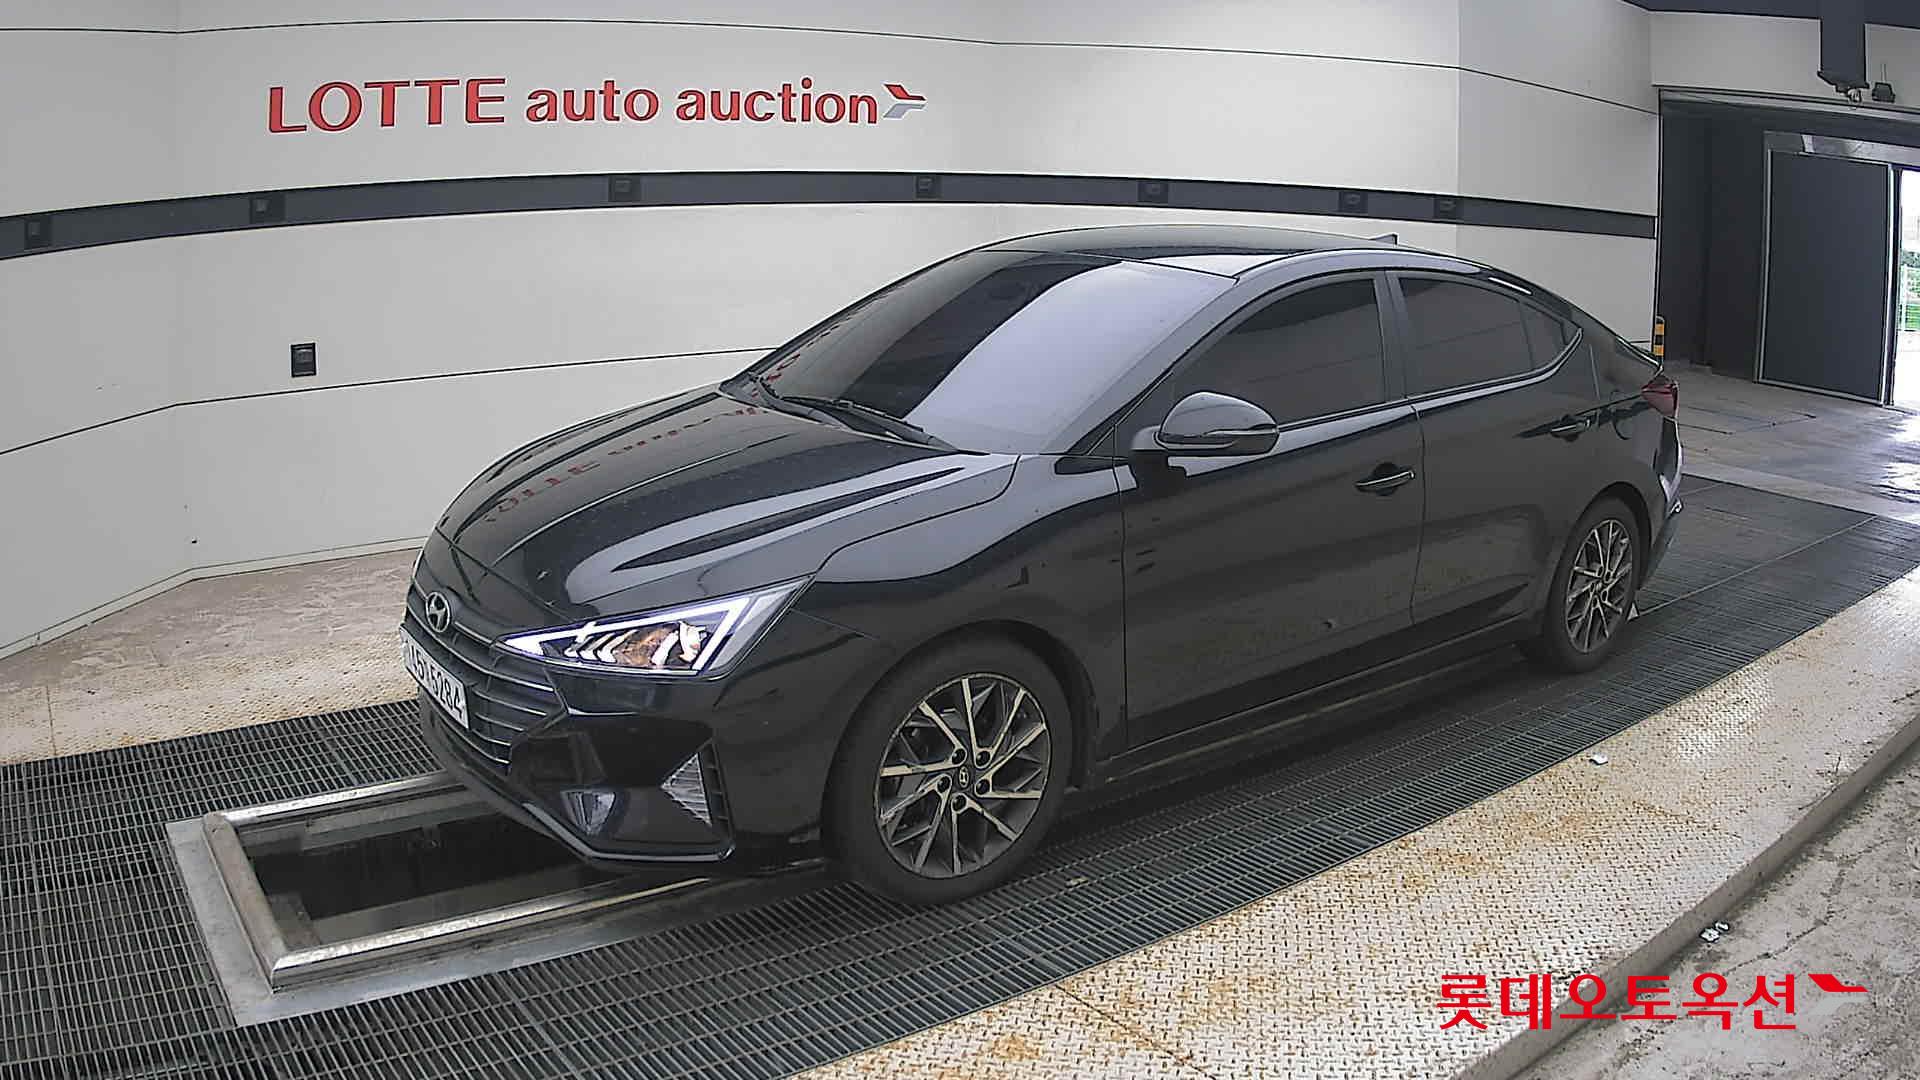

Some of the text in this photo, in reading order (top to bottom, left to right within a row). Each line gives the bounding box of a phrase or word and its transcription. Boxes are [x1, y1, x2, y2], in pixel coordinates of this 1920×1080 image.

[269, 77, 879, 133] LOTTE auto auction
